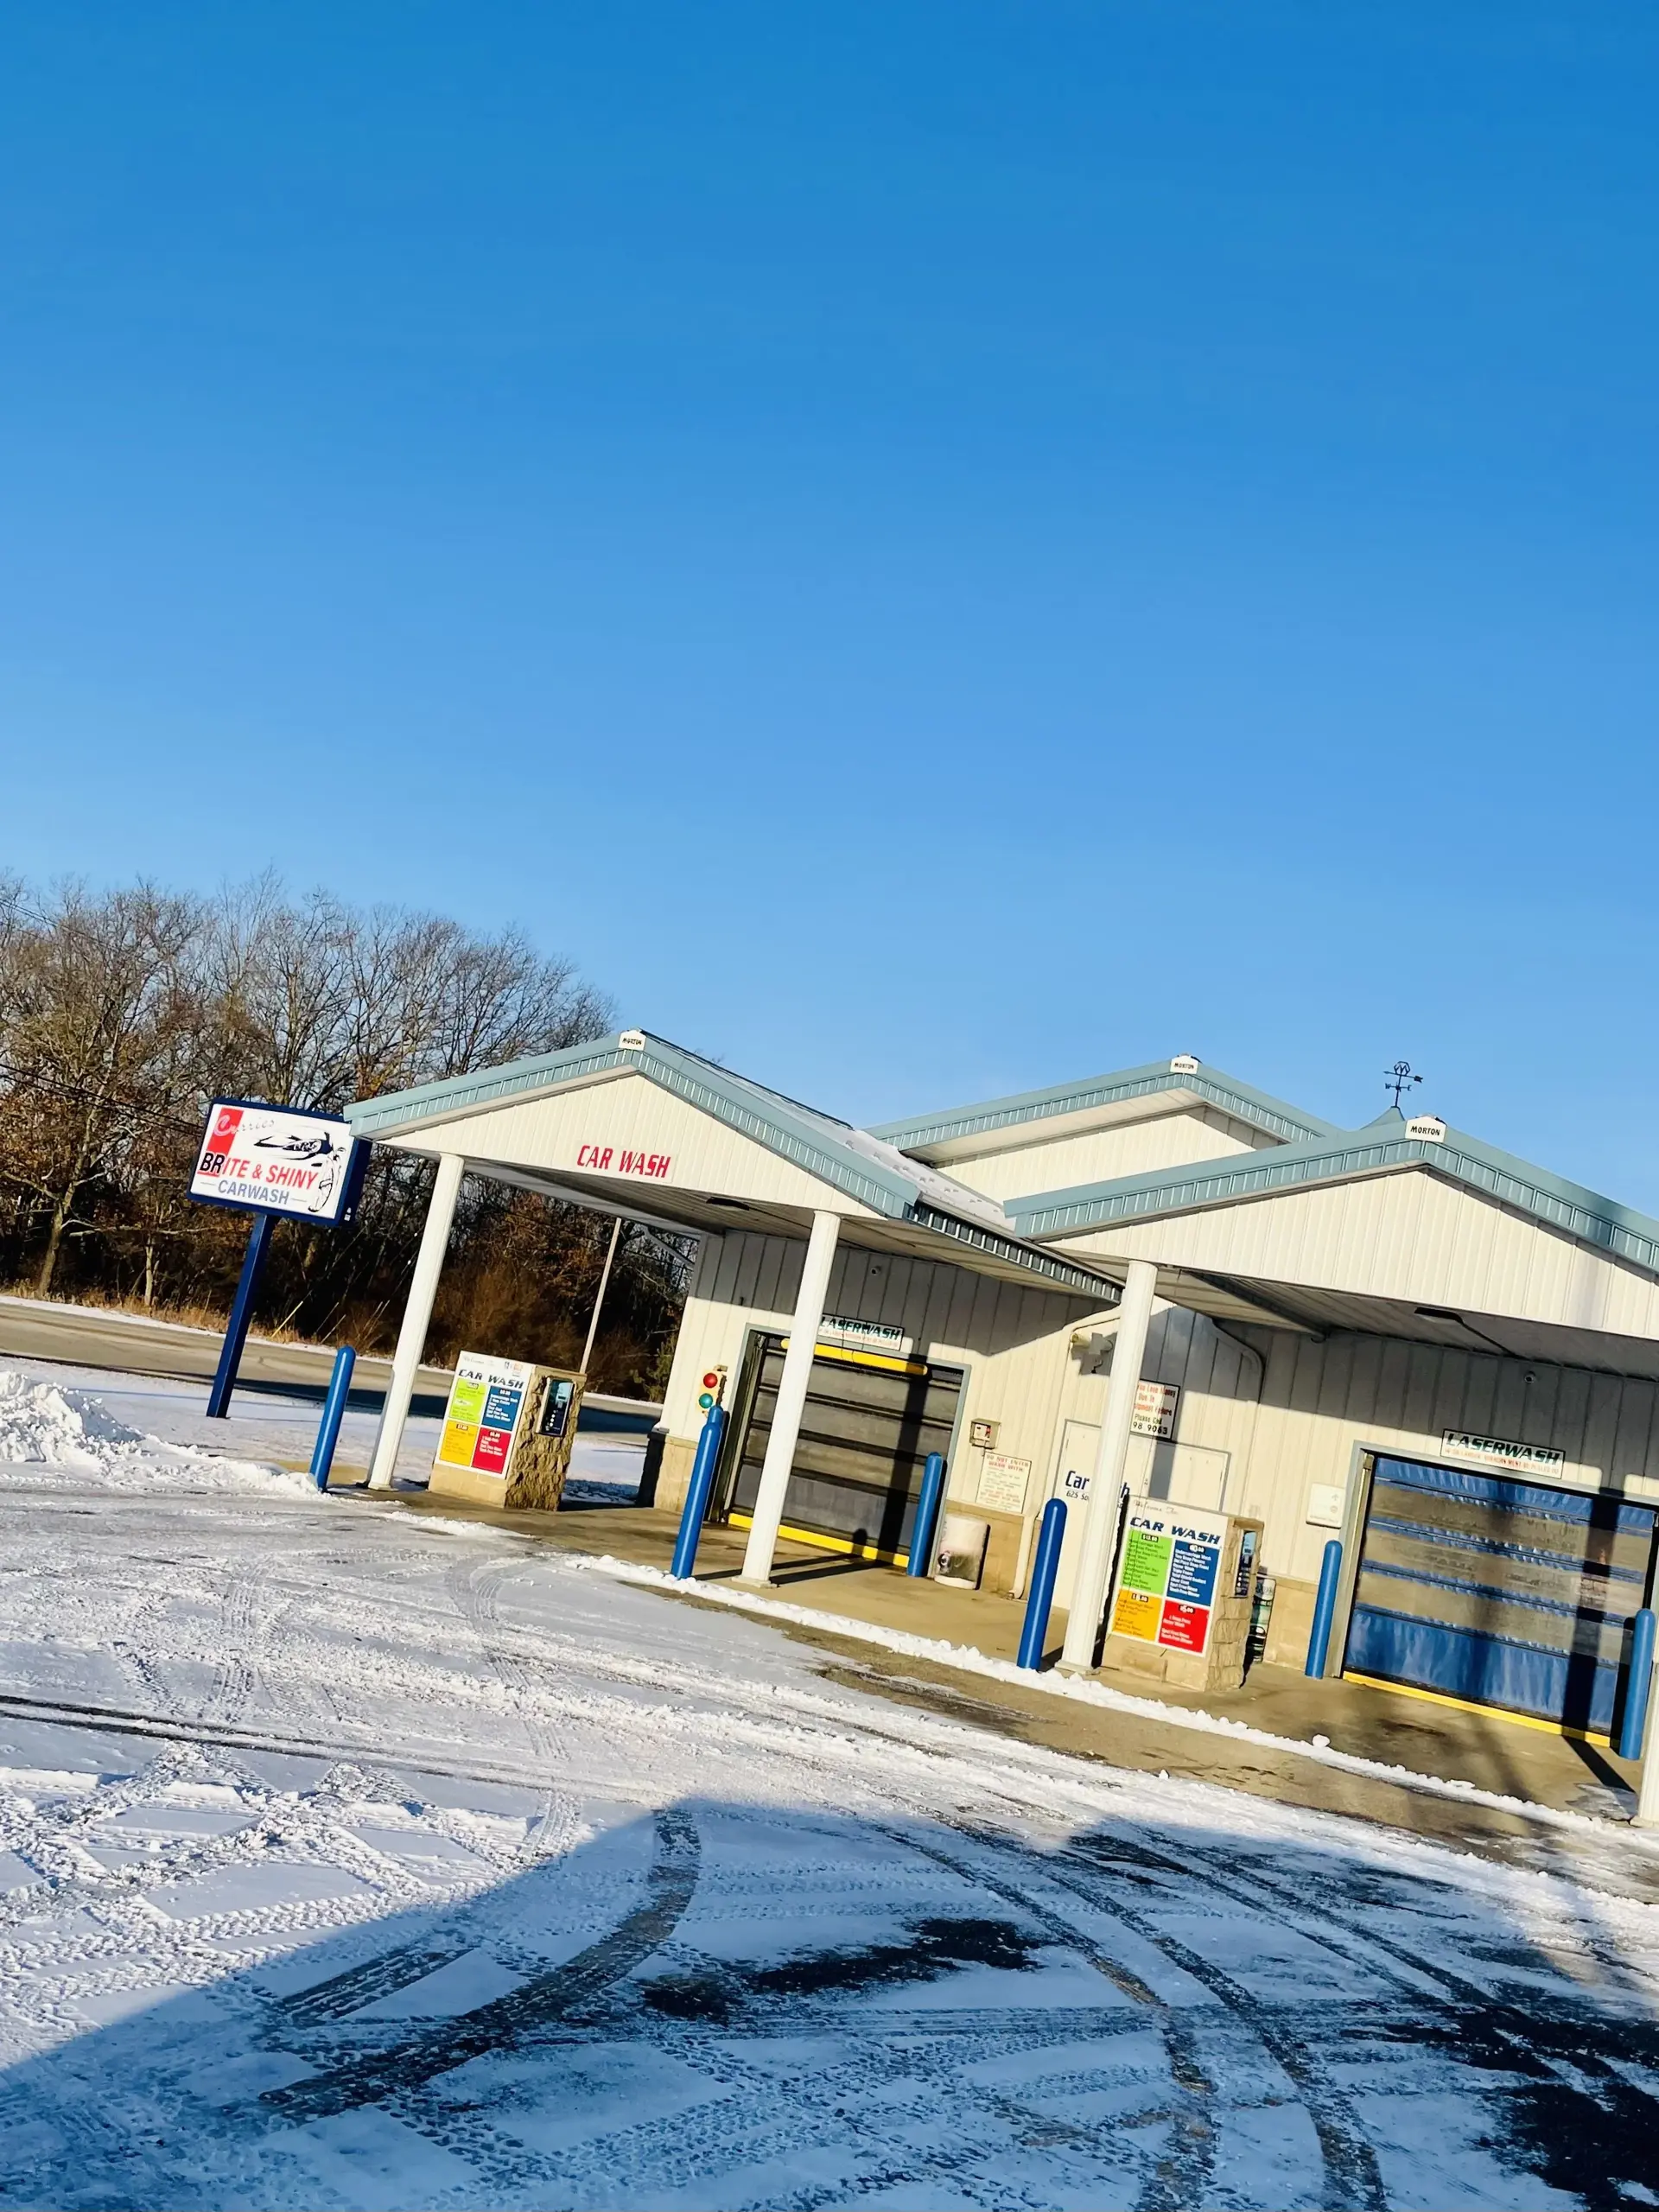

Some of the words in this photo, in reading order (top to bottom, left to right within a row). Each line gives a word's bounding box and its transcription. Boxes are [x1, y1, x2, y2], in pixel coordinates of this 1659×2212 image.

[1410, 1125, 1440, 1136] MORTON
[199, 1152, 250, 1179] BRITE
[251, 1164, 264, 1180] &
[265, 1165, 319, 1191] SHINY
[577, 1145, 613, 1170] CAR
[619, 1150, 671, 1179] WASH
[218, 1179, 289, 1205] CARWASH
[819, 1316, 901, 1340] LASERWASH
[458, 1369, 483, 1382] CAR
[487, 1375, 525, 1389] WASH
[1147, 1424, 1168, 1435] 9063
[1446, 1433, 1560, 1465] LASERWASH
[1065, 1470, 1090, 1490] Car
[1066, 1490, 1078, 1499] 625
[1129, 1516, 1164, 1533] CAR
[1171, 1525, 1221, 1545] WASH
